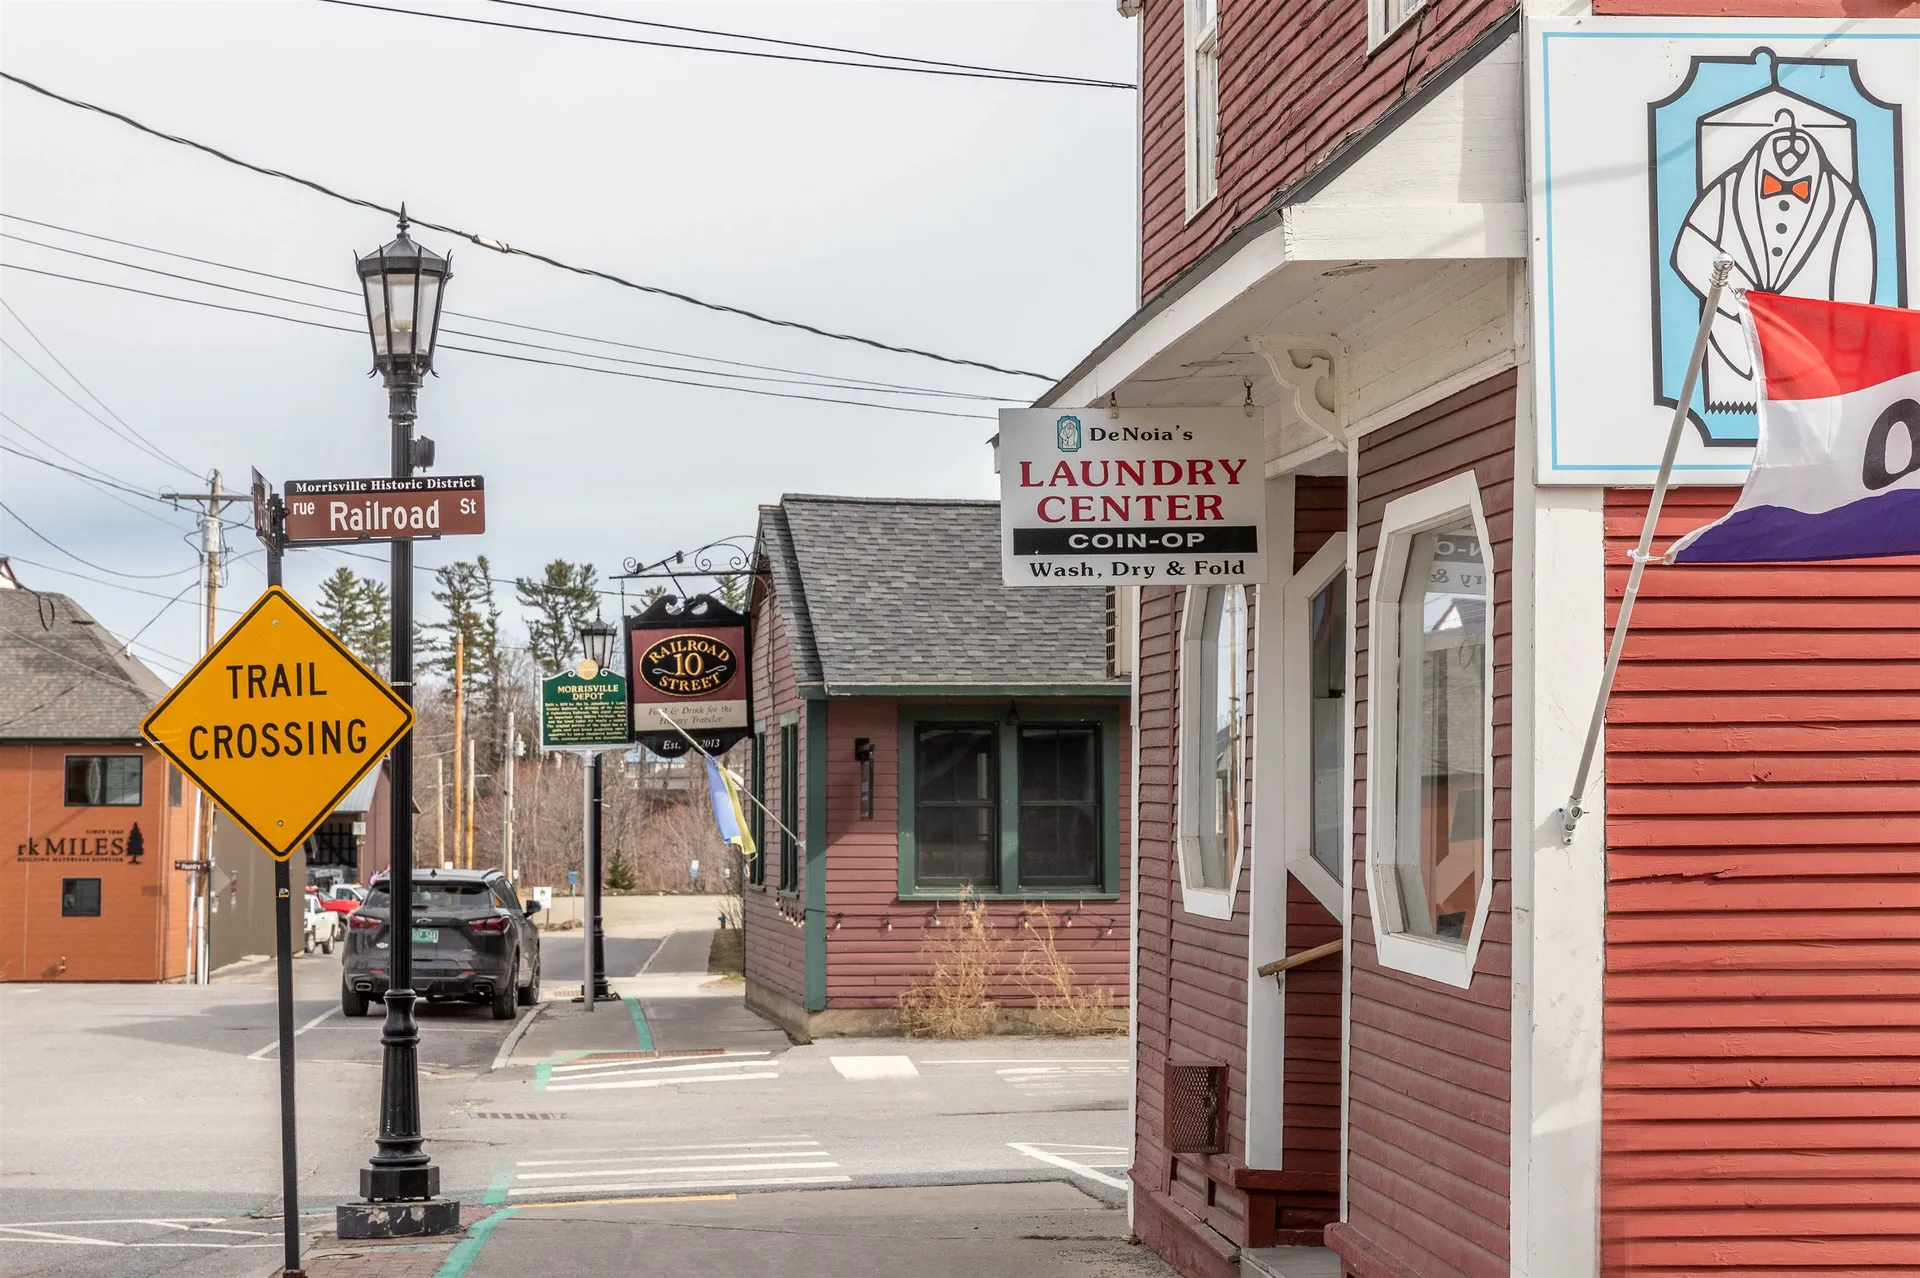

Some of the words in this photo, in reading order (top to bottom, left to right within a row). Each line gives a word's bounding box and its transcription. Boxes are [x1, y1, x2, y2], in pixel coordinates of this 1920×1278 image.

[1090, 425, 1193, 441] DeNoia's
[1019, 458, 1247, 487] LAUNDRY
[296, 481, 367, 493] Morrisville
[371, 479, 423, 491] Historic
[427, 477, 477, 489] District
[293, 501, 315, 516] rue
[330, 499, 440, 531] Railroad
[460, 498, 477, 515] St
[1037, 494, 1225, 523] CENTER
[1068, 533, 1205, 549] COIN-OP
[1029, 561, 1102, 579] Wash,
[1111, 561, 1155, 579] Dry
[1166, 560, 1186, 576] &
[1194, 560, 1246, 576] Fold
[648, 640, 730, 664] RAILROAD
[673, 652, 704, 677] 10
[226, 662, 327, 699] TRAIL
[557, 684, 619, 693] MORRISVILLE
[659, 672, 720, 691] STREET
[572, 692, 604, 700] DEPOT
[682, 706, 705, 715] Drink
[706, 705, 718, 715] for
[721, 704, 733, 713] the
[692, 715, 723, 724] Traveler
[189, 718, 367, 760] CROSSING
[663, 740, 681, 750] Est.
[701, 739, 720, 748] 2013
[18, 836, 40, 856] rk
[45, 837, 124, 856] MILES
